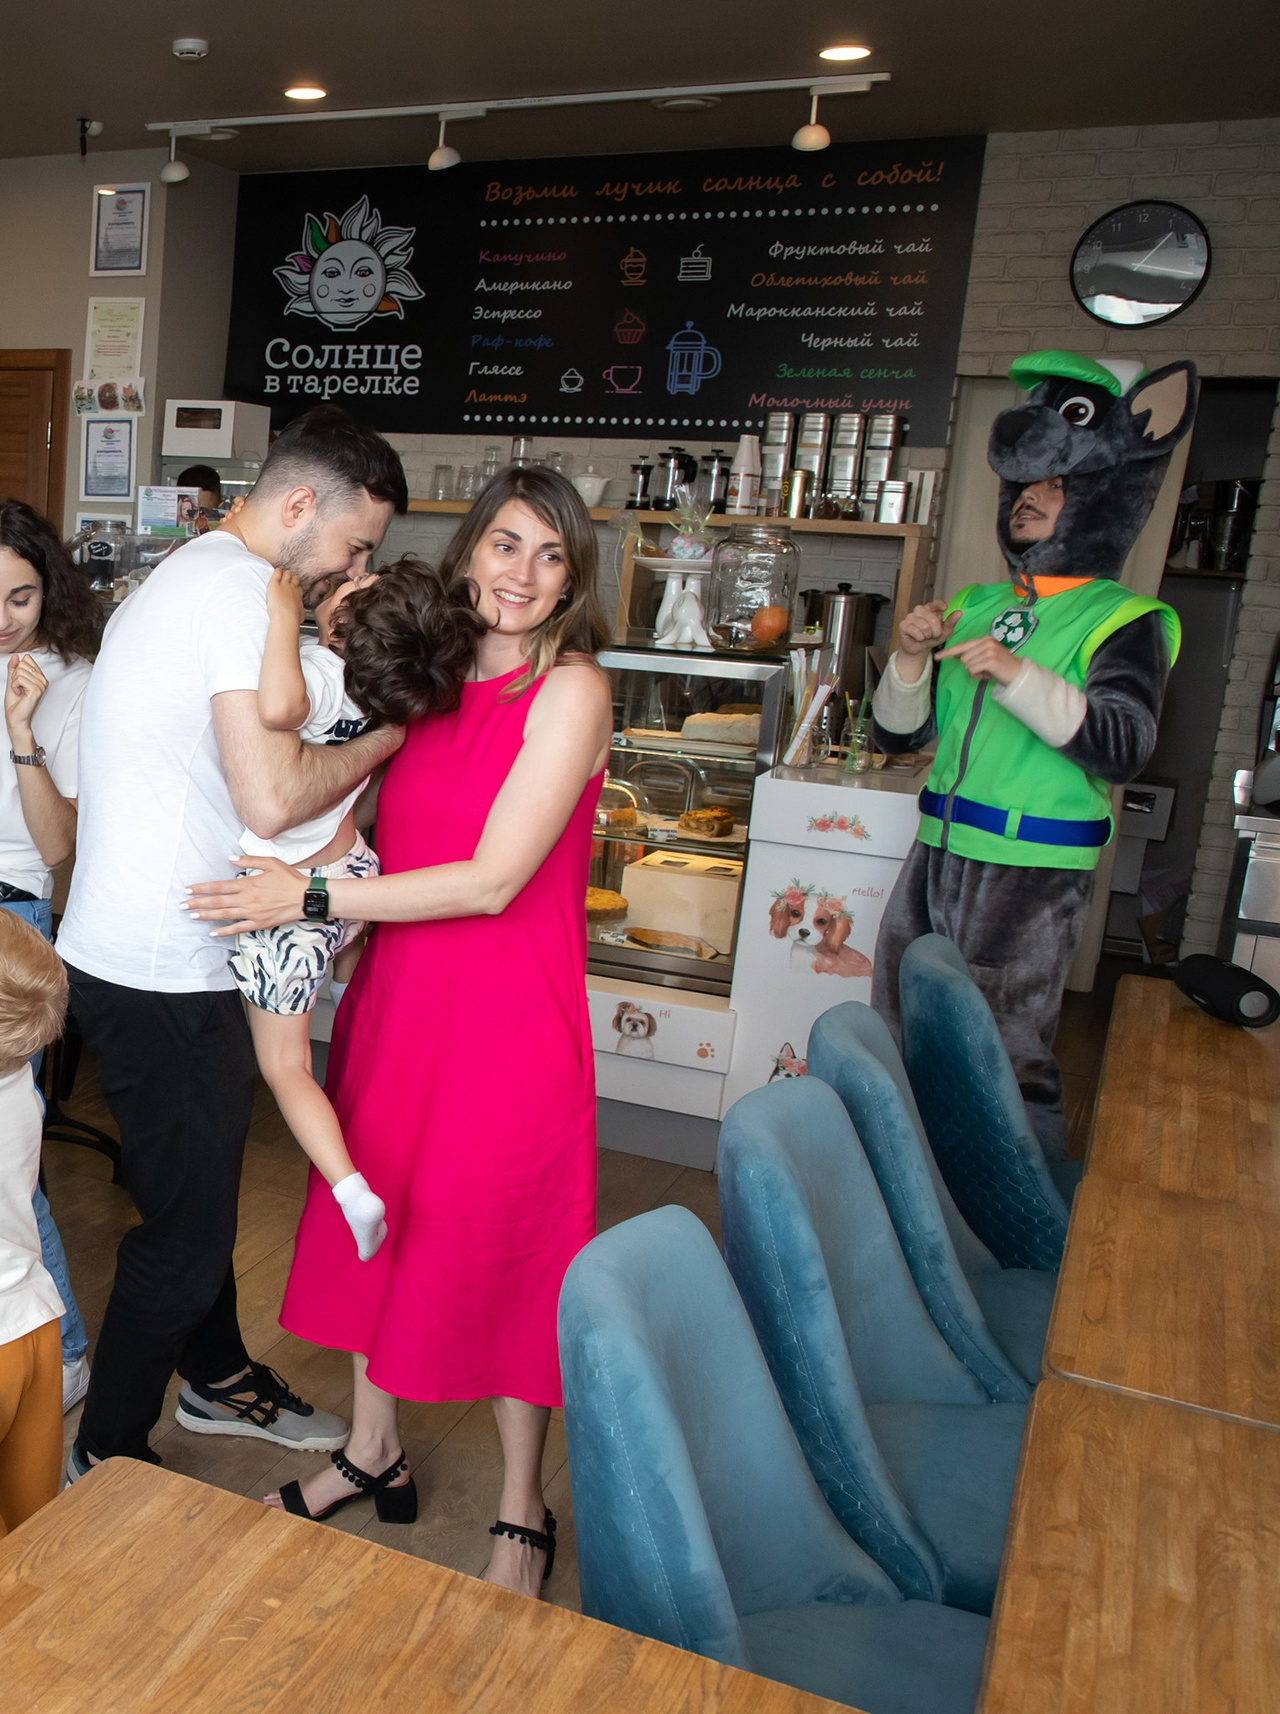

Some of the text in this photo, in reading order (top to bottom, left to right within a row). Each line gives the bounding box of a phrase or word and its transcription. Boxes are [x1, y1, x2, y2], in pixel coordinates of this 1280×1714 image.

[485, 161, 944, 205] Возьми лучик солнца с собой!
[1138, 213, 1150, 223] 12
[1111, 223, 1122, 232] 11
[769, 238, 932, 260] Фруктовый чай
[1091, 240, 1102, 250] 10
[480, 251, 567, 265] Капучино
[1083, 265, 1091, 274] 9
[475, 278, 572, 294] Американо
[751, 270, 928, 287] Облепиховый чай
[1089, 286, 1096, 296] 8
[473, 306, 542, 322] Эспрессо
[727, 301, 924, 320] Марокканский чай
[472, 335, 553, 350] Раф-кофе
[801, 333, 920, 350] Черный чай
[265, 338, 422, 374] Солнце
[469, 362, 523, 375] Гляссе
[776, 363, 916, 379] Зеленая сенча
[264, 375, 419, 400] в тарелке
[465, 390, 527, 403] Латтэ
[749, 393, 912, 412] Молочный улун
[852, 887, 884, 898] Hello!
[659, 1009, 670, 1019] Hi
